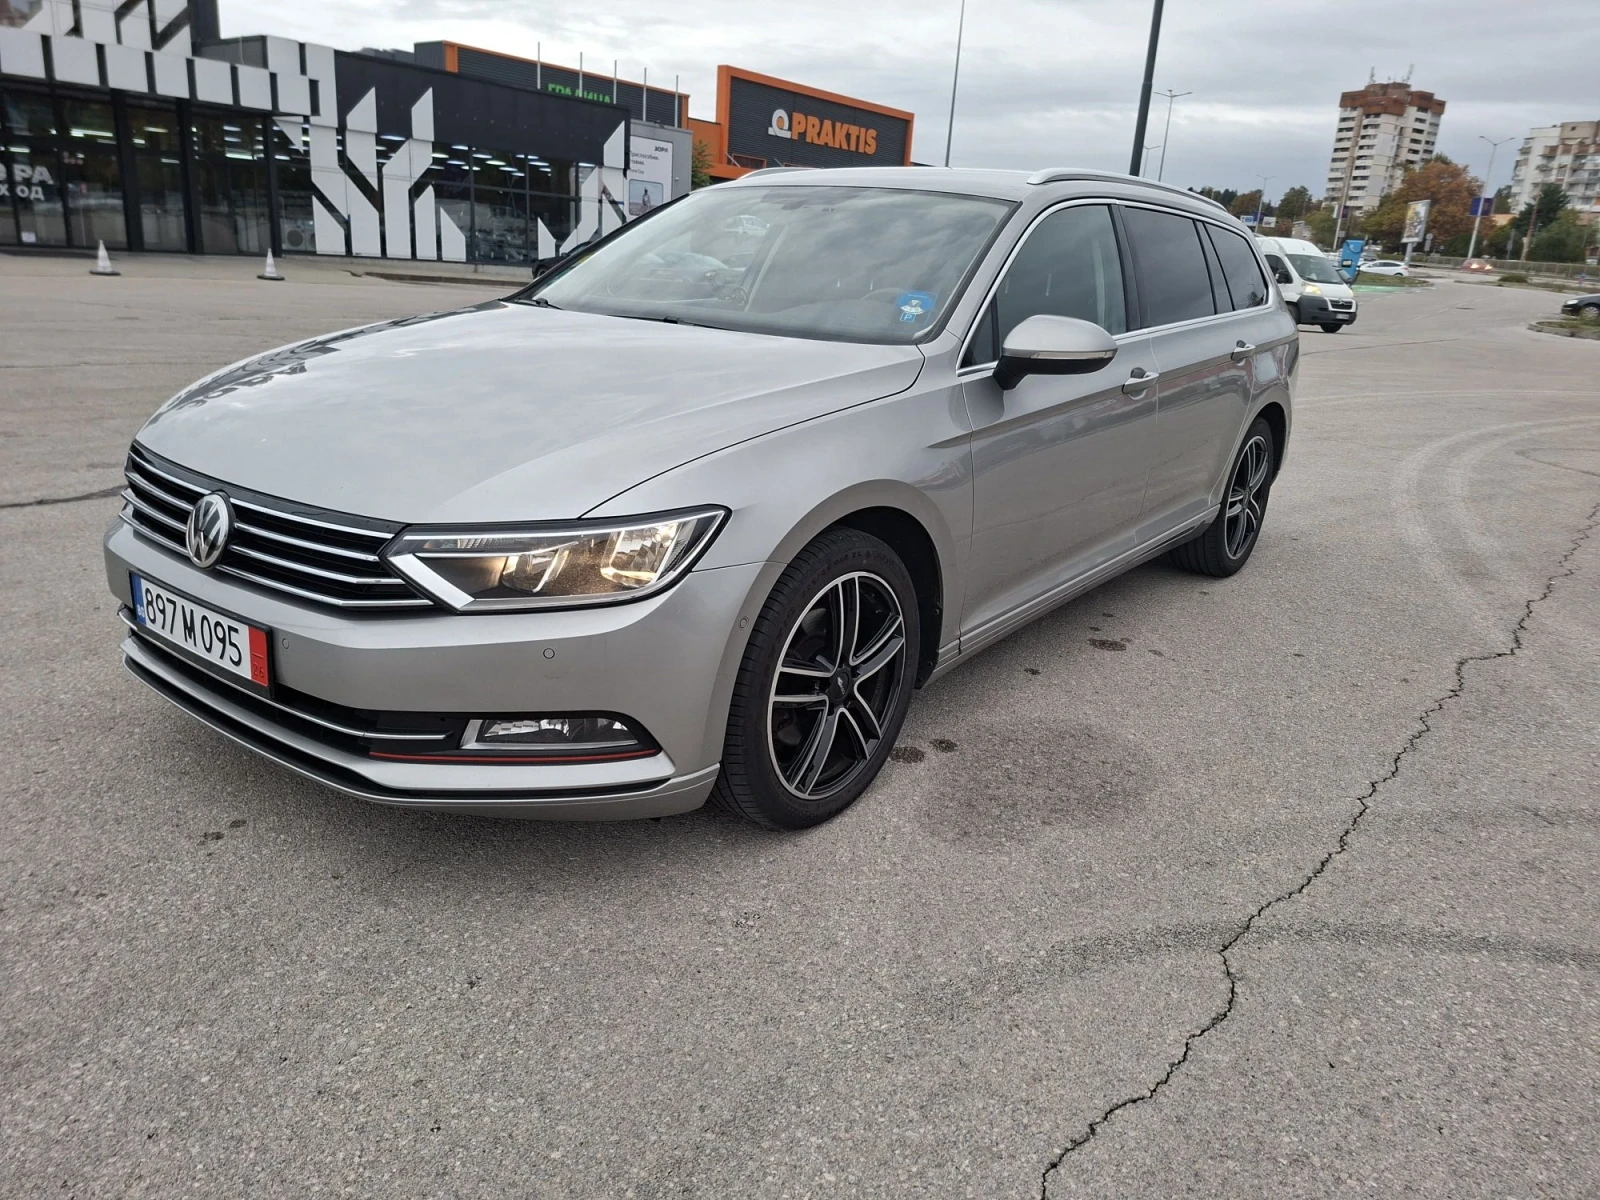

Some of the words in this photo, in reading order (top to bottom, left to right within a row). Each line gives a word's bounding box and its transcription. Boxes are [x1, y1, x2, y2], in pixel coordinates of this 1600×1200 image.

[791, 112, 877, 155] PRAKTIS
[144, 587, 177, 635] 897
[181, 604, 198, 648] M
[200, 614, 242, 667] 095
